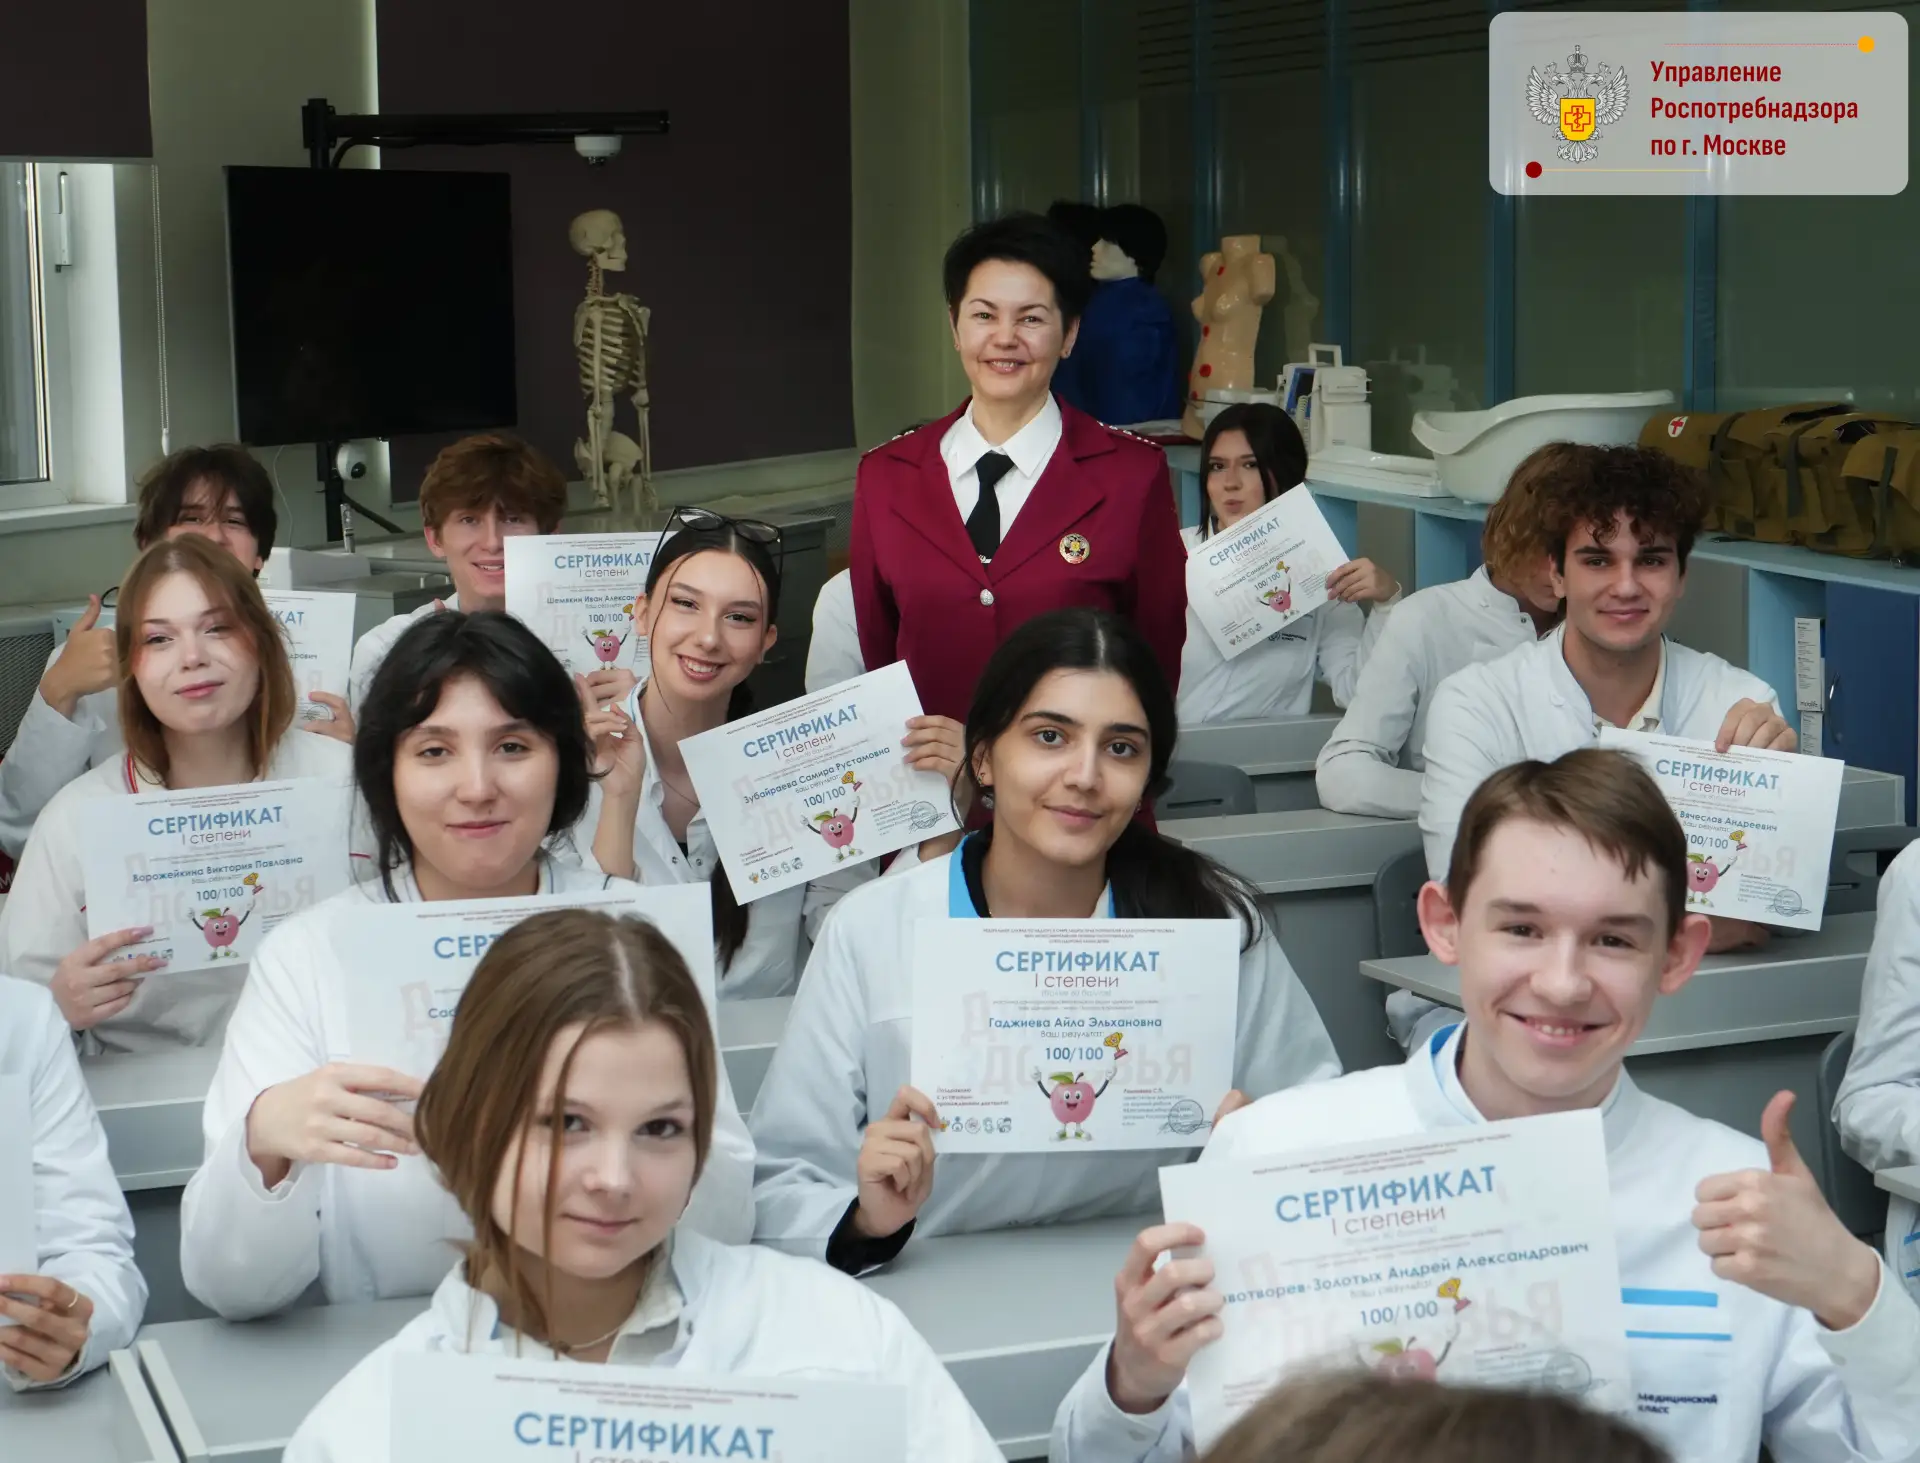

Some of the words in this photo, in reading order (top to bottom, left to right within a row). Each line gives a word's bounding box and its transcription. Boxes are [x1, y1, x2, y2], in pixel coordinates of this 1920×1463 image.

[1209, 517, 1282, 566] СЕРТИФИКАТ
[1235, 538, 1269, 563] степени
[555, 552, 651, 569] СЕРТИФИКАТ
[585, 567, 629, 578] степени
[1254, 572, 1281, 591] 100/100
[584, 595, 603, 603] Иван
[589, 613, 624, 623] 100/100
[743, 704, 859, 758] СЕРТИФИКАТ
[783, 732, 836, 759] степени
[743, 780, 798, 804] Зубайраева
[798, 766, 835, 785] Самира
[836, 747, 890, 775] Рустамовна
[1656, 759, 1779, 790] СЕРТИФИКАТ
[803, 786, 846, 808] 100/100
[1689, 781, 1746, 798] степени
[148, 806, 283, 836] СЕРТИФИКАТ
[1680, 811, 1723, 825] Вячеслав
[1725, 816, 1778, 832] Андреевич
[190, 829, 251, 845] степени
[1685, 834, 1729, 850] 100/100
[133, 866, 204, 883] Ворожейкина
[206, 862, 253, 875] Виктория
[255, 855, 303, 869] Павловна
[196, 886, 244, 901] 100/100
[995, 950, 1160, 972] СЕРТИФИКАТ
[1044, 975, 1119, 988] степени
[989, 1017, 1051, 1030] Гаджиева
[1054, 1016, 1085, 1028] Айла
[1088, 1017, 1162, 1028] Эльхановна
[1040, 1031, 1060, 1039] Ваш
[1045, 1047, 1103, 1062] 100/100
[1275, 1165, 1498, 1223] СЕРТИФИКАТ
[1345, 1206, 1446, 1235] степени
[1387, 1258, 1452, 1281] Андрей
[1455, 1241, 1589, 1271] Александрович
[1360, 1301, 1439, 1327] 100/100
[514, 1411, 775, 1460] СЕРТИФИКАТ
